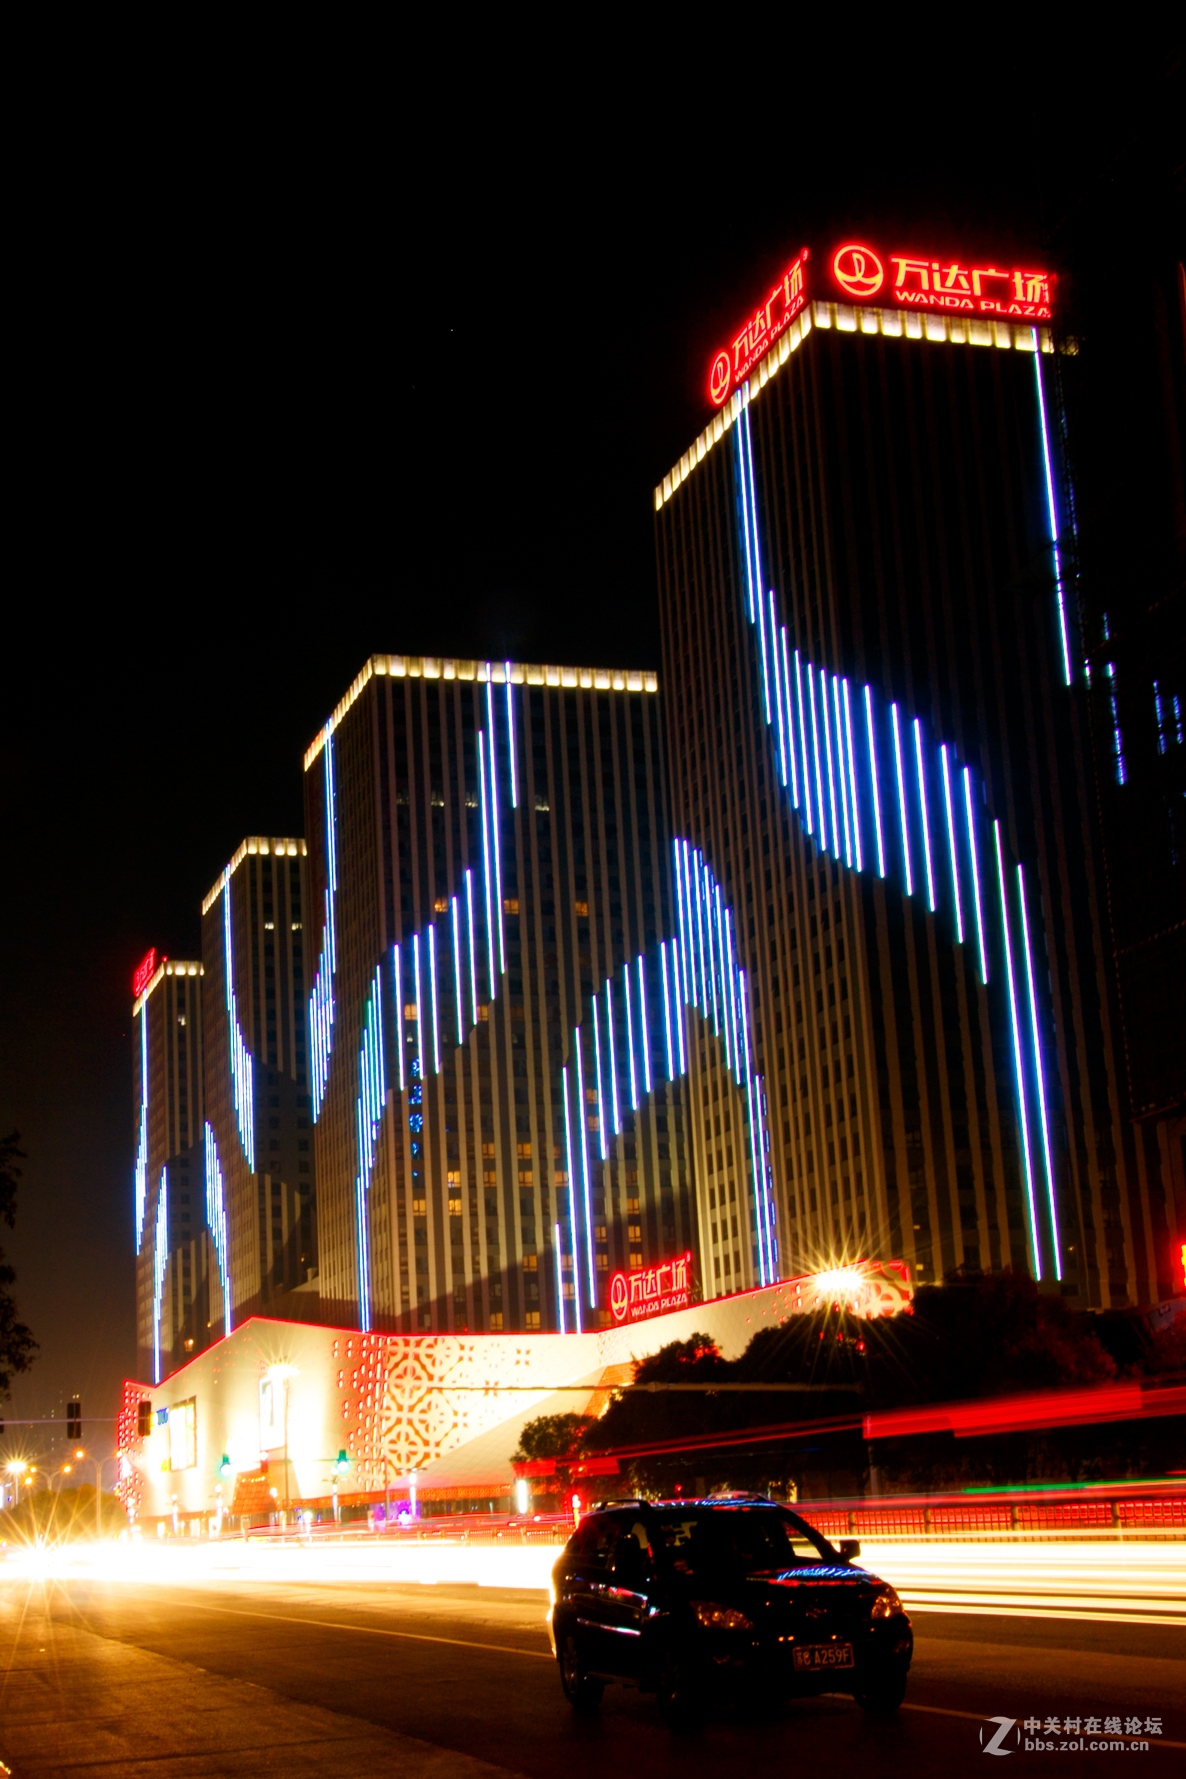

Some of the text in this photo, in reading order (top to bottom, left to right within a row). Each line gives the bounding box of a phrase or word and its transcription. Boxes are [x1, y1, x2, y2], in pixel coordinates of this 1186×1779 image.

[890, 257, 1050, 304] 万达广场
[730, 258, 804, 371] 万达广场
[895, 289, 1051, 319] WANDA PLAZA
[733, 294, 805, 383] WANDA PLAZA
[628, 1258, 687, 1303] 万达广场
[630, 1293, 687, 1317] WANDA PLAZA
